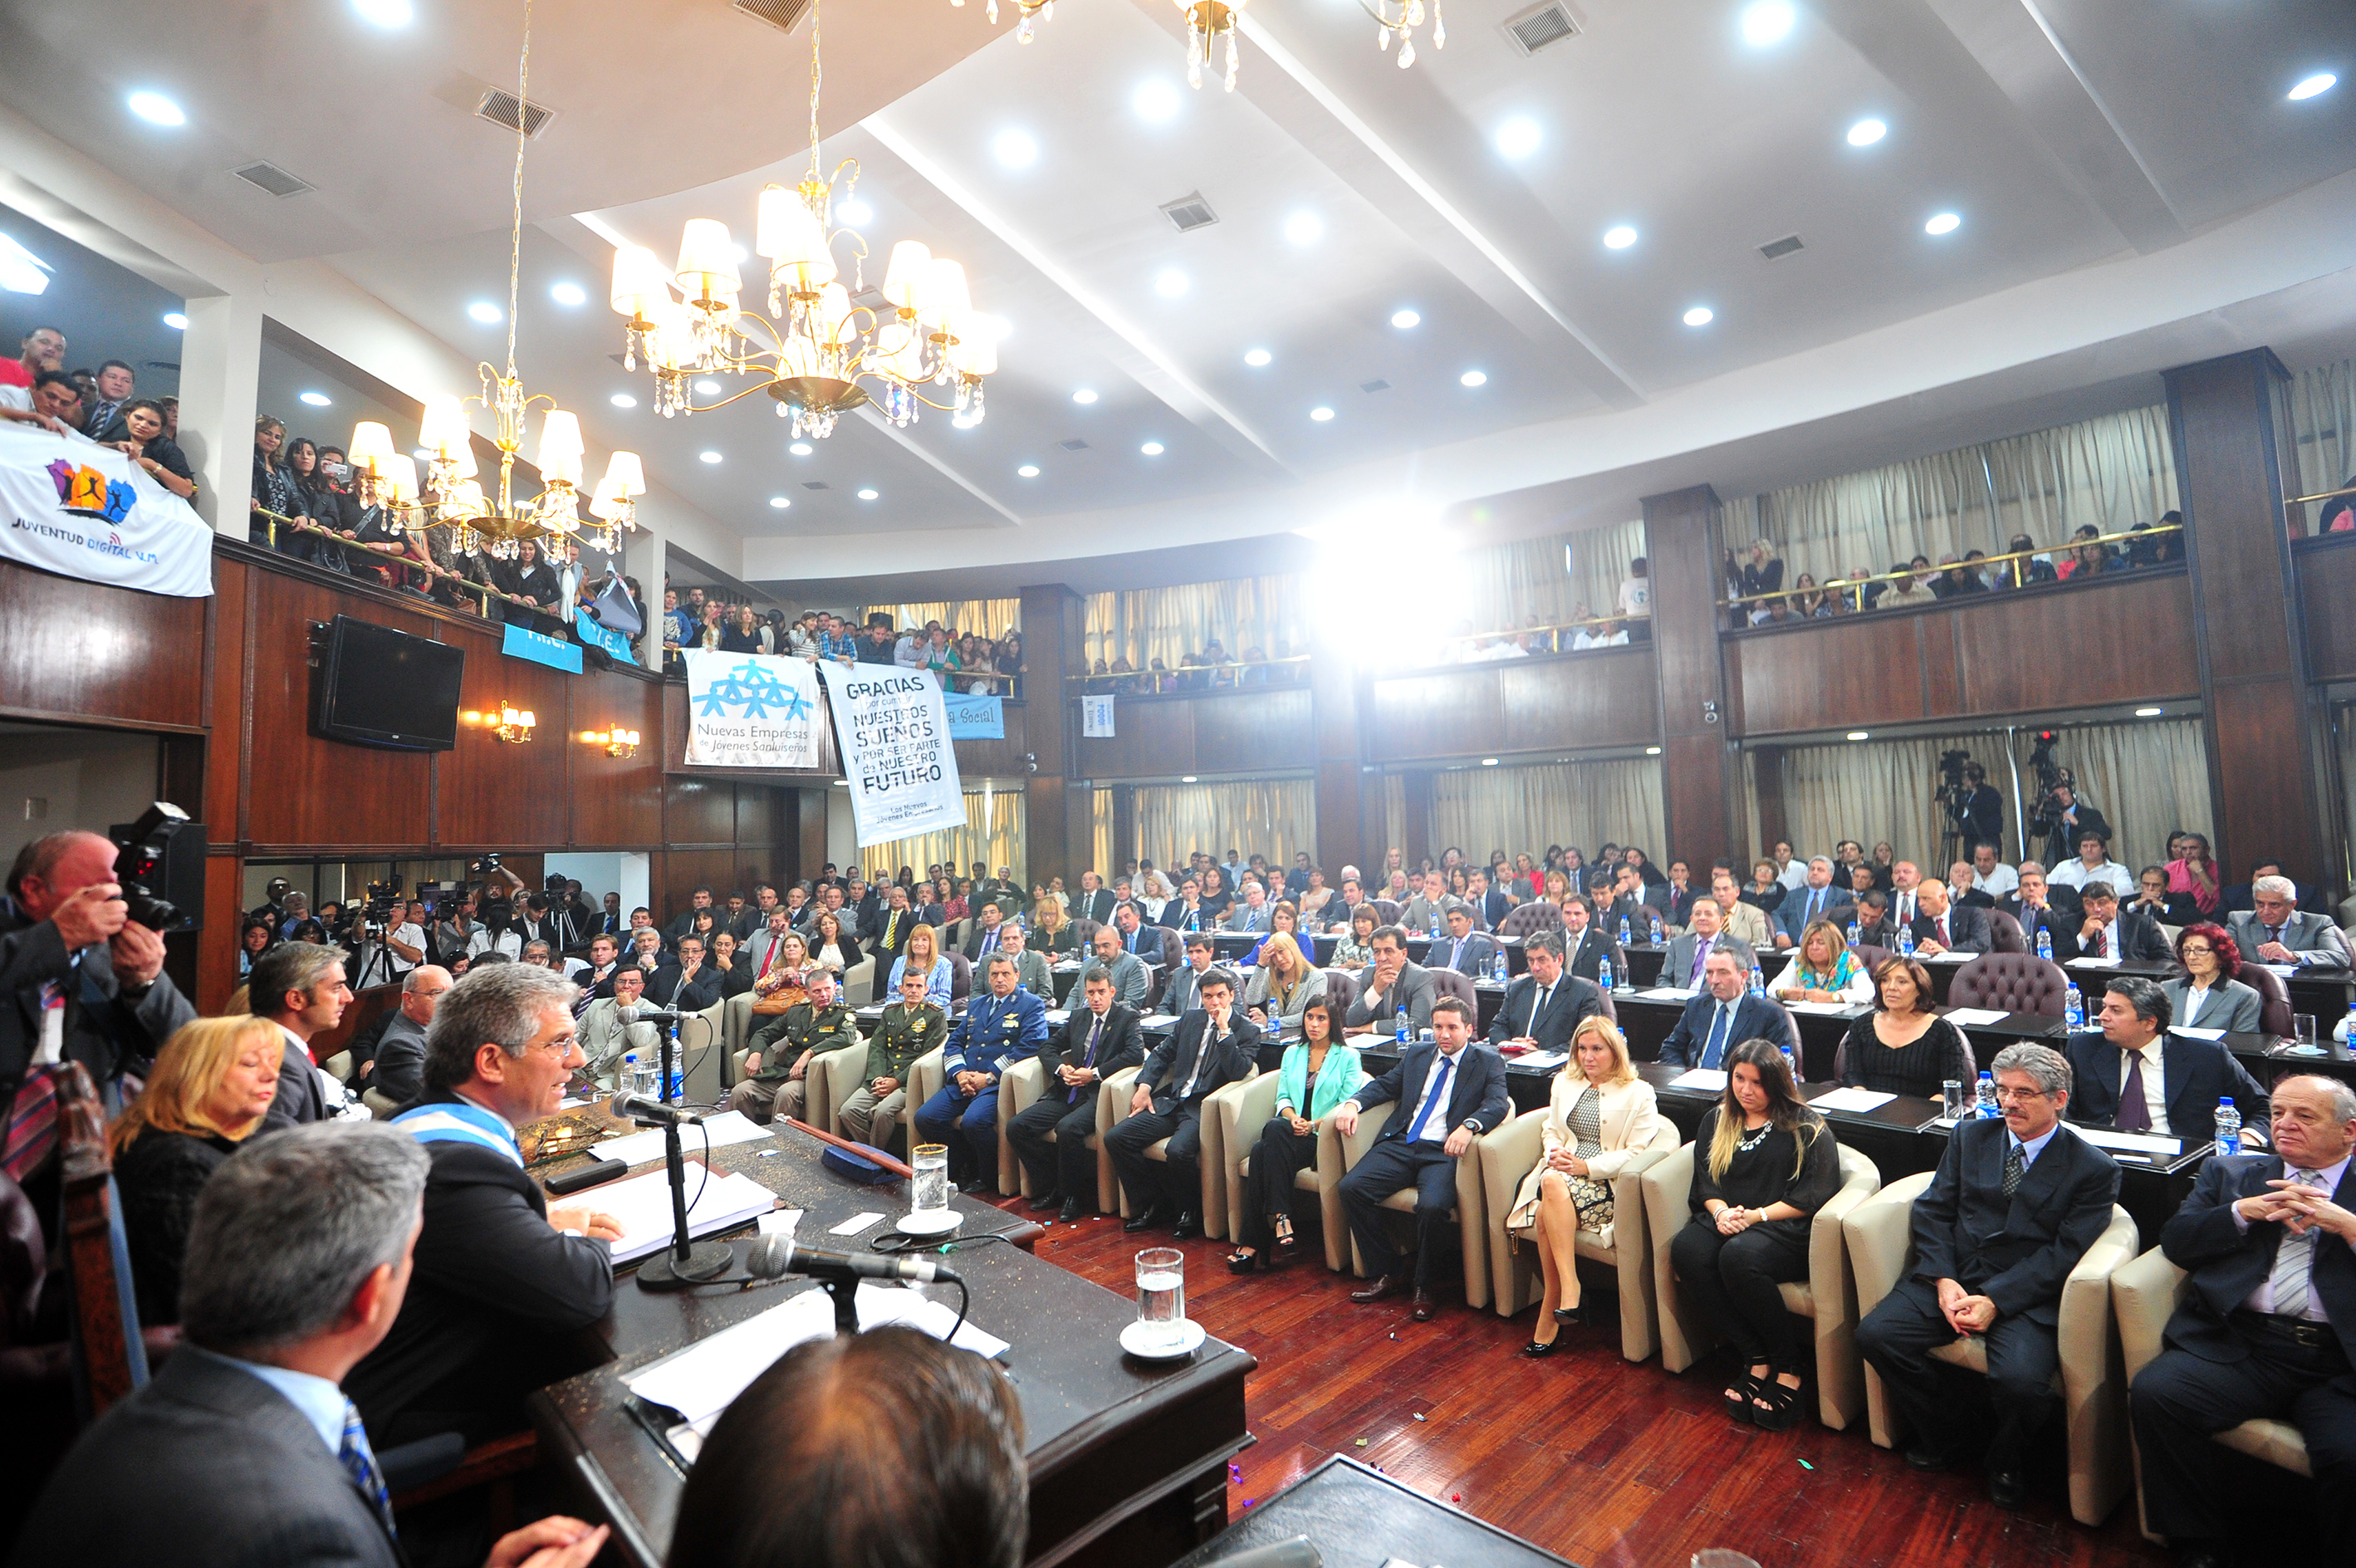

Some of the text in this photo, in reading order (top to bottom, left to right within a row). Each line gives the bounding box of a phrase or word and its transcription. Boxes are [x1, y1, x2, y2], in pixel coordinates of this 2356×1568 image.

[12, 517, 84, 546] JUVENTUD
[87, 537, 131, 559] DIGITAL
[846, 677, 924, 699] GRACIAS
[854, 704, 928, 728] NUESTROS
[960, 706, 994, 724] Social
[698, 723, 808, 740] Nuevas Empresas
[855, 720, 933, 747] SUEÑOS
[711, 740, 750, 753] Jóvenes
[752, 741, 807, 753] Sanluiseños
[854, 738, 941, 765] y POR SER PARTE
[863, 751, 937, 774] de NUESTRO
[863, 765, 941, 794] FUTURO
